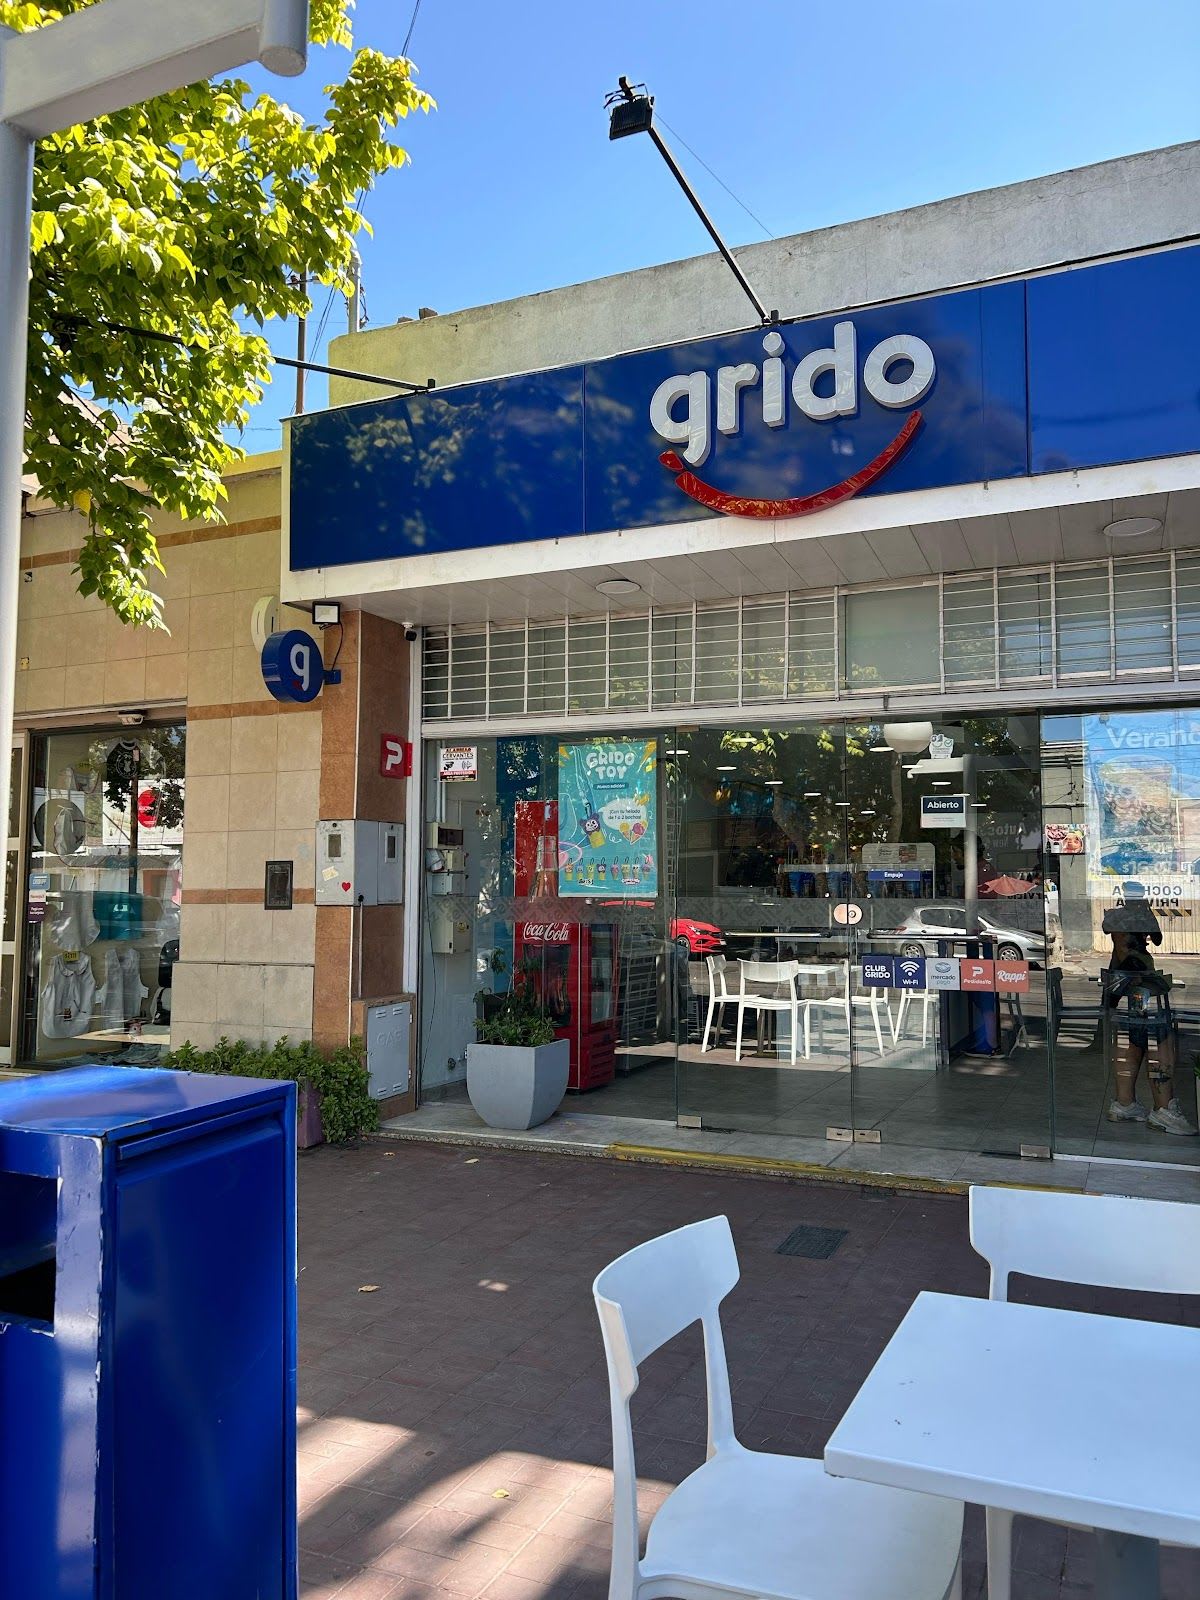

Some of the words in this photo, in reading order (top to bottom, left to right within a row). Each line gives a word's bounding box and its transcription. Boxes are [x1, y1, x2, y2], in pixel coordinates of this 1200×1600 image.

[650, 321, 936, 467] grido
[290, 643, 310, 692] g
[586, 751, 635, 767] GRIDO
[595, 766, 627, 779] TOY
[927, 801, 959, 809] Abierto
[997, 970, 1027, 983] Rappi
